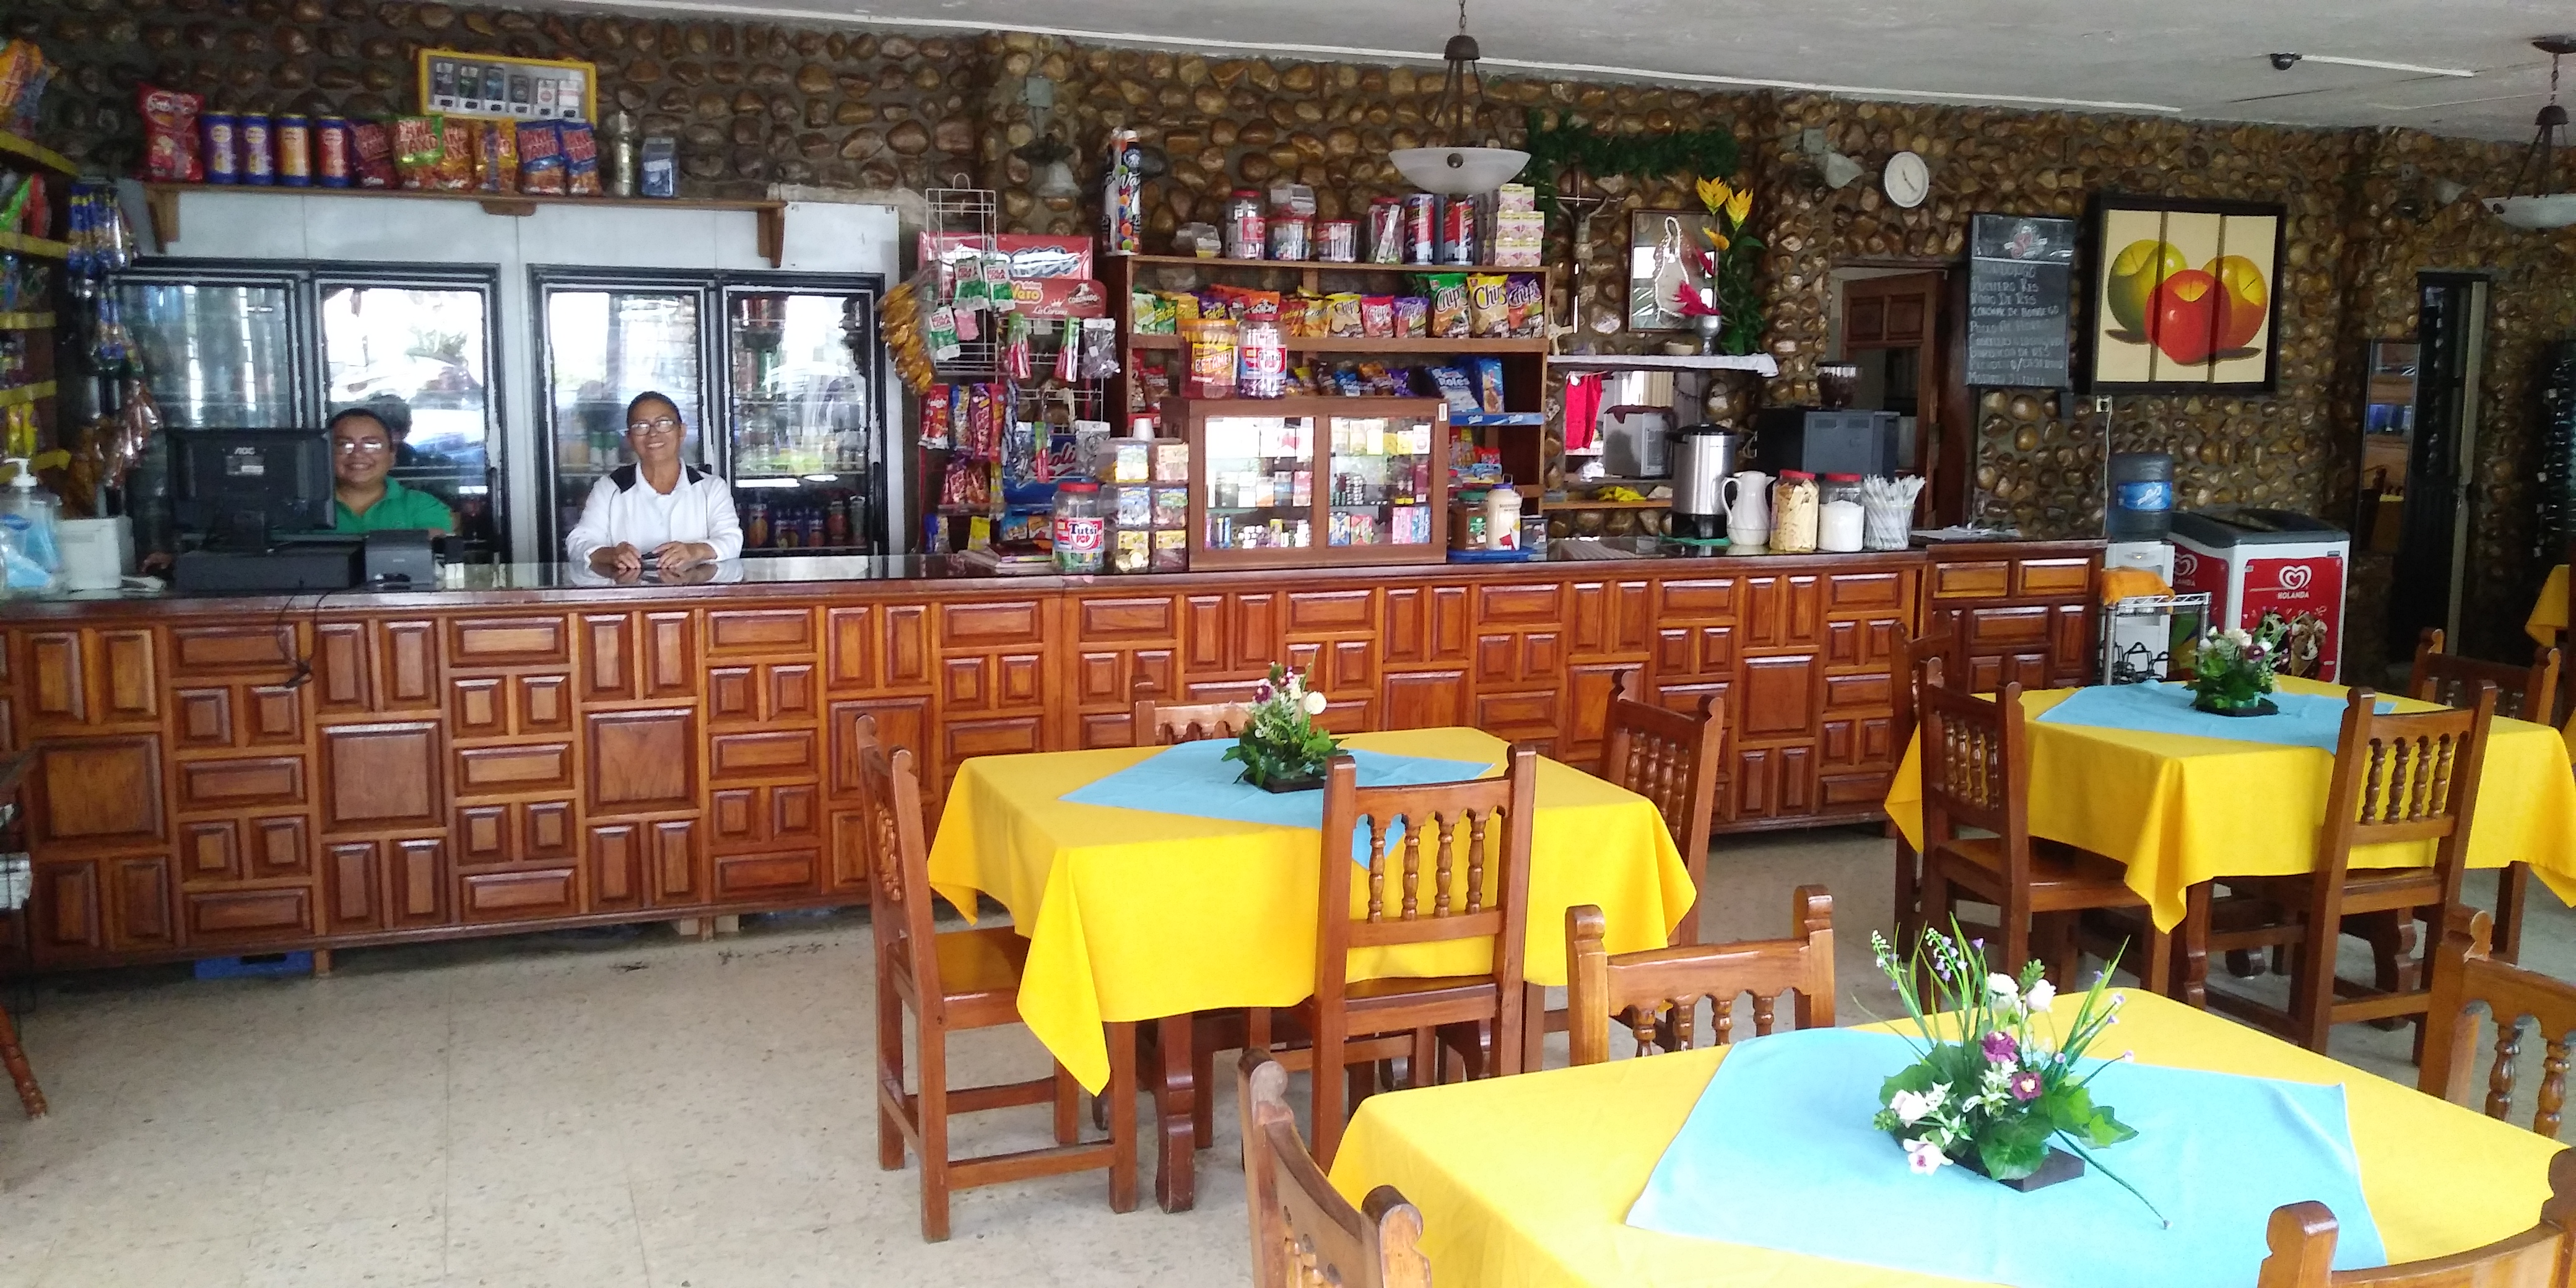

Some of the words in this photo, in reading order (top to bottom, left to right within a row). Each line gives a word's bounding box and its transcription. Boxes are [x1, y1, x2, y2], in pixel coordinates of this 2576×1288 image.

[1438, 376, 1471, 386] Roles
[1069, 523, 1097, 534] Tutsi
[1076, 535, 1090, 543] POP
[2278, 591, 2310, 600] HOLANDA
